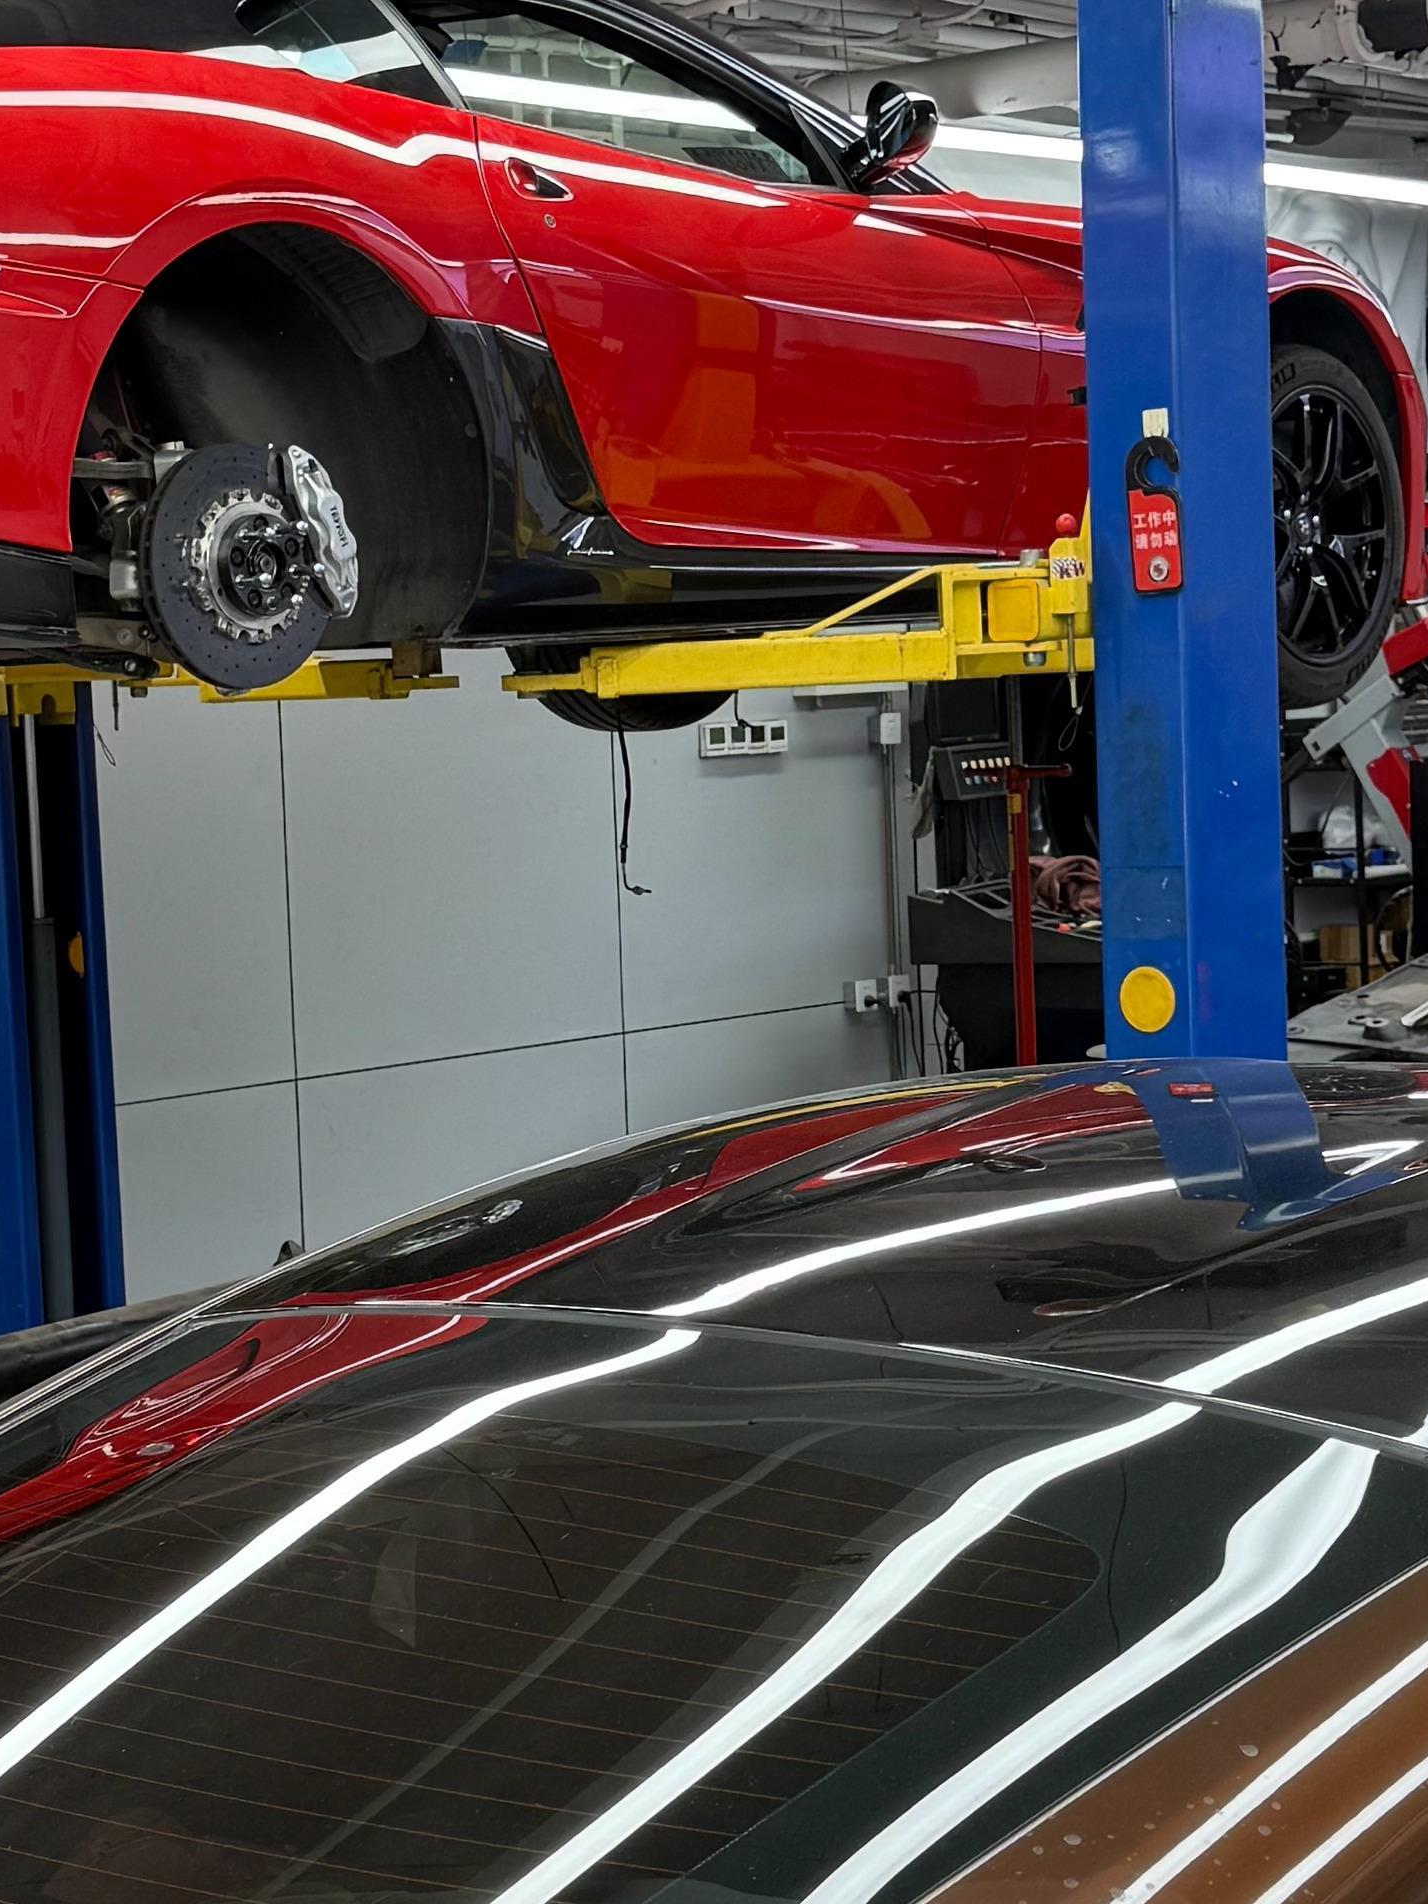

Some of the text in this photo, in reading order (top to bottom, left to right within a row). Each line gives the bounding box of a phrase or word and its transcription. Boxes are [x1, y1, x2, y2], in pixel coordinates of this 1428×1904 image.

[1134, 510, 1177, 529] 工作中
[1134, 531, 1177, 550] 请勿动
